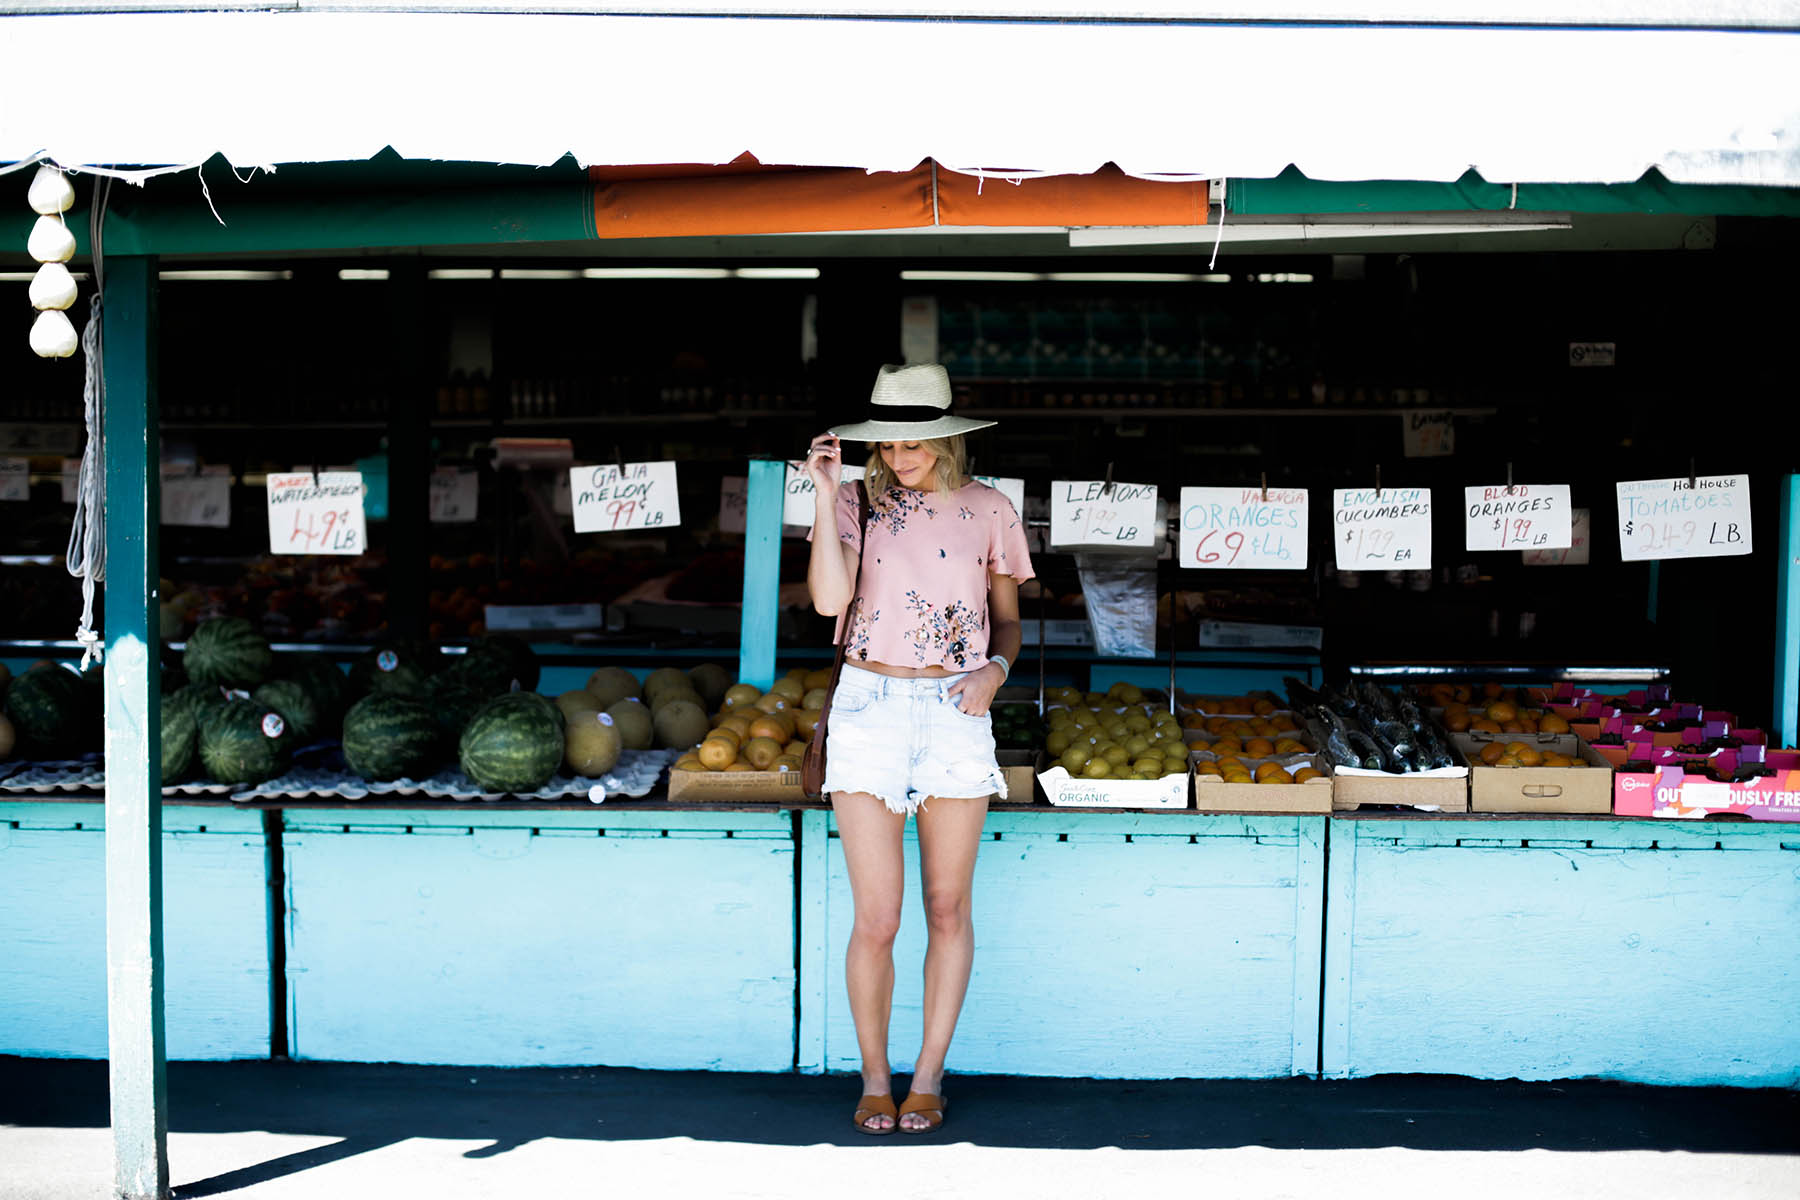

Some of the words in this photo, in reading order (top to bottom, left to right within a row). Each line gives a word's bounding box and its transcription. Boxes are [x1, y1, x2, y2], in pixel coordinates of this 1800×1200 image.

[579, 481, 654, 505] MELON
[1067, 483, 1156, 503] LEMONS
[1184, 504, 1298, 529] ORANGES
[1336, 504, 1429, 525] CUCUMBERS
[1469, 497, 1553, 518] ORANGES
[645, 512, 663, 525] LB
[334, 529, 355, 550] LB
[1116, 526, 1137, 540] LB
[1533, 533, 1548, 545] LB
[1394, 549, 1412, 561] EA
[1059, 792, 1110, 803] ORGANIC
